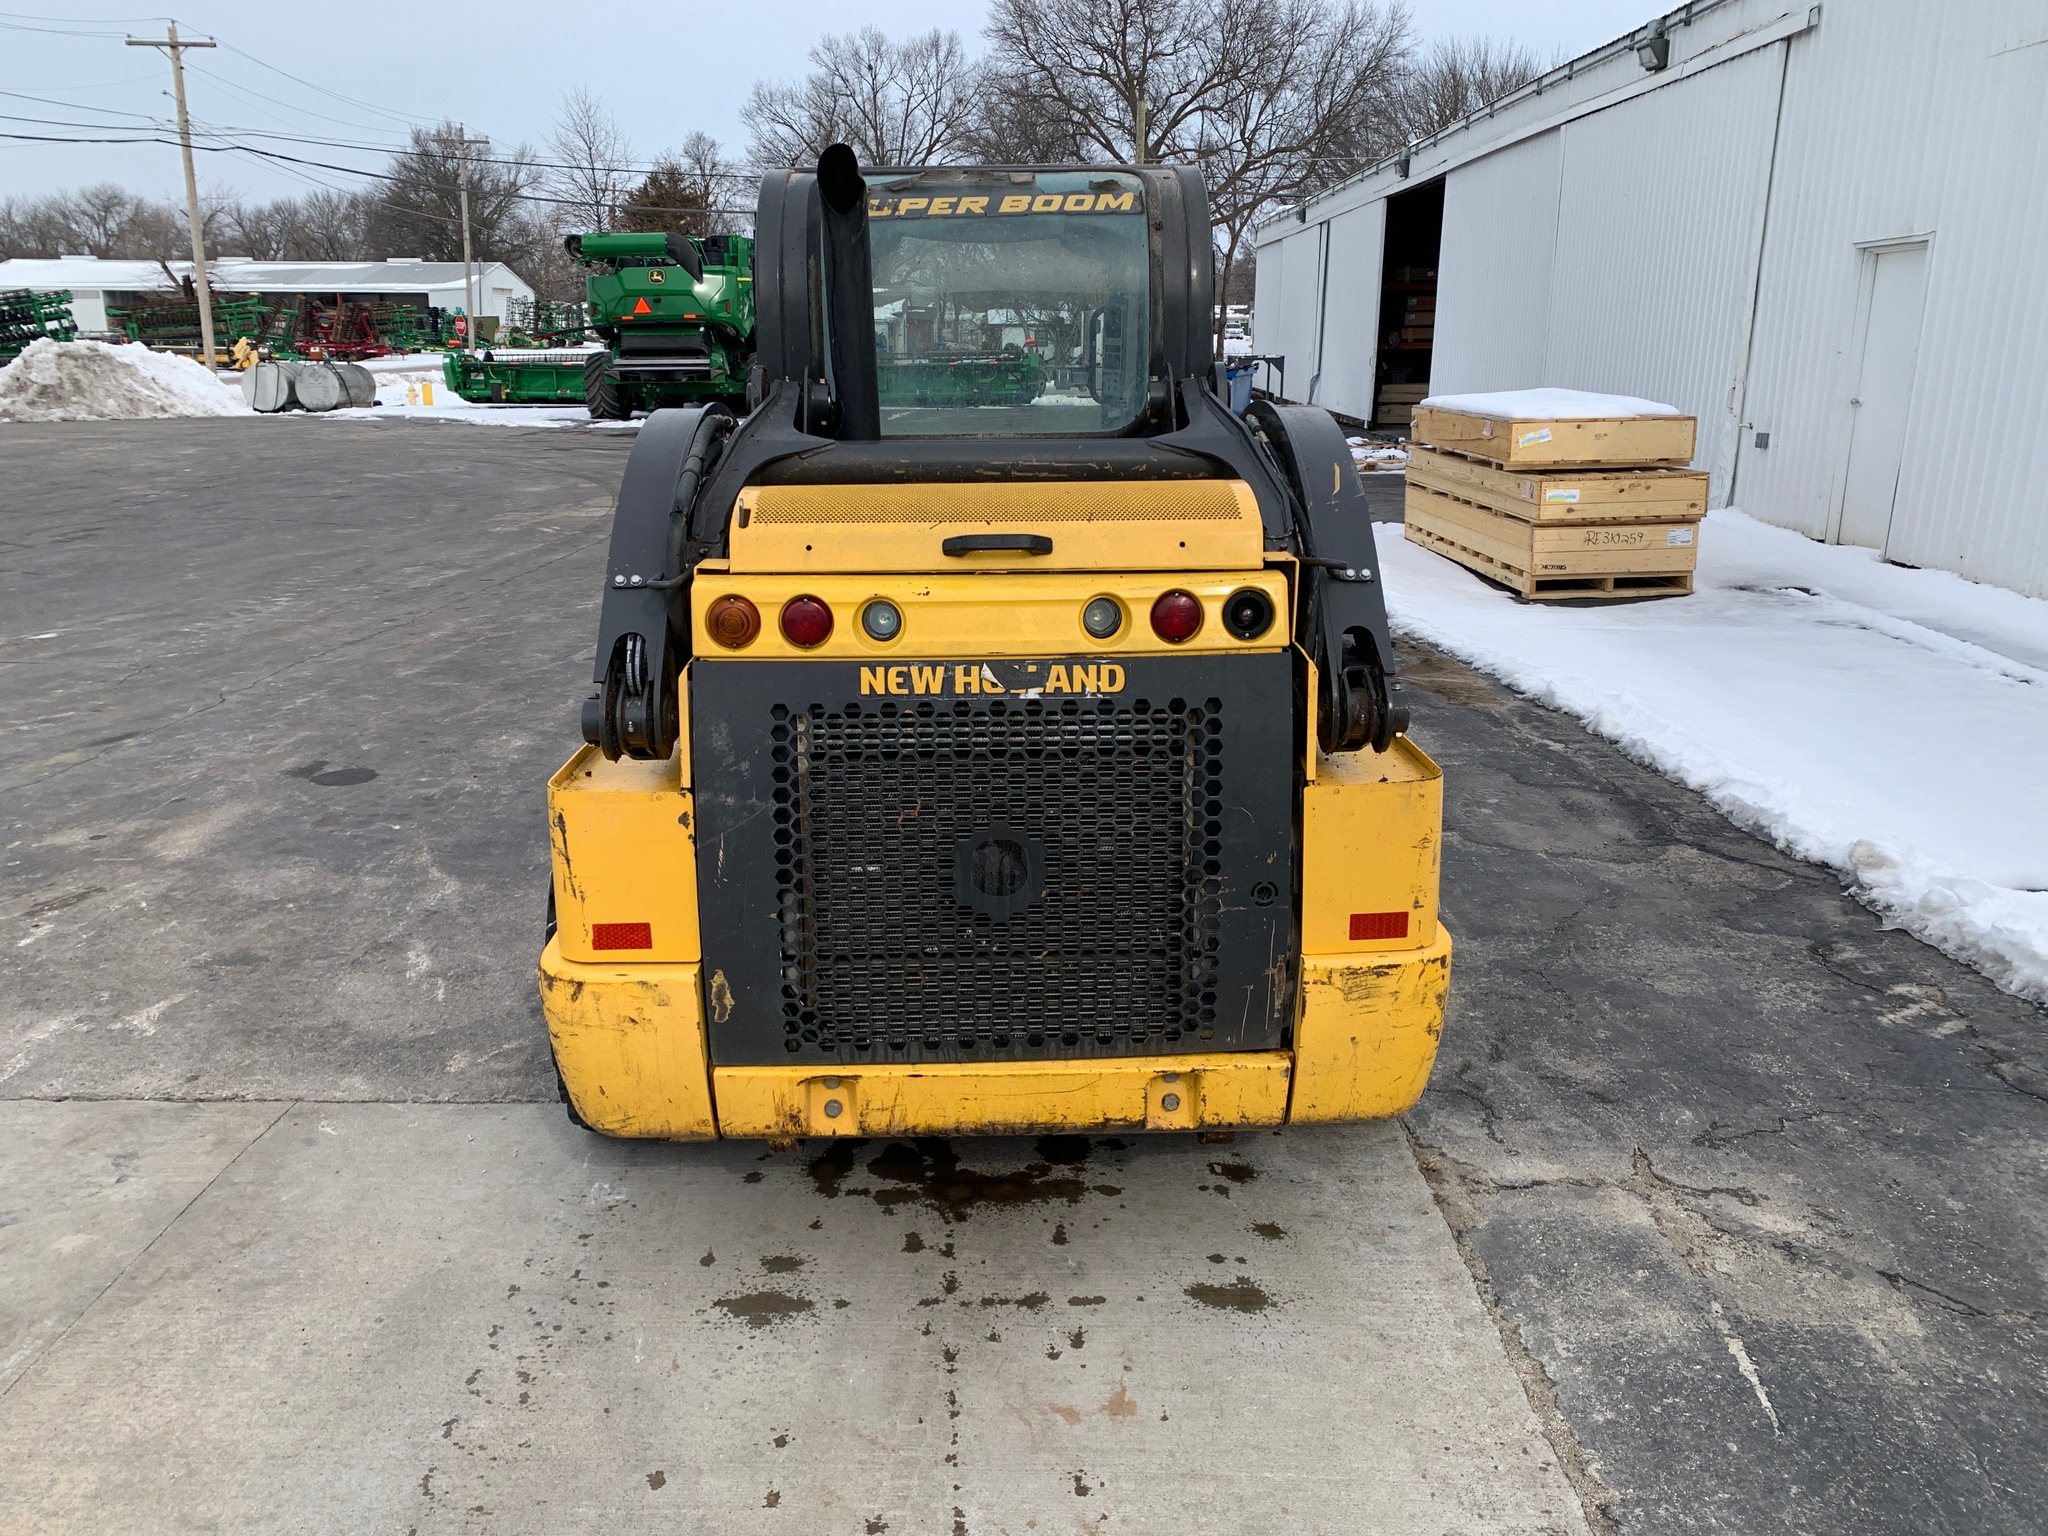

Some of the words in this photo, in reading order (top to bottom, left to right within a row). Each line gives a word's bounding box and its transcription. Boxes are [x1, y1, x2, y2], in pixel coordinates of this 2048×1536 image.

[868, 197, 990, 217] UPER
[998, 192, 1135, 213] BOOM
[860, 666, 945, 695] NEW
[955, 664, 1126, 694] HAND
